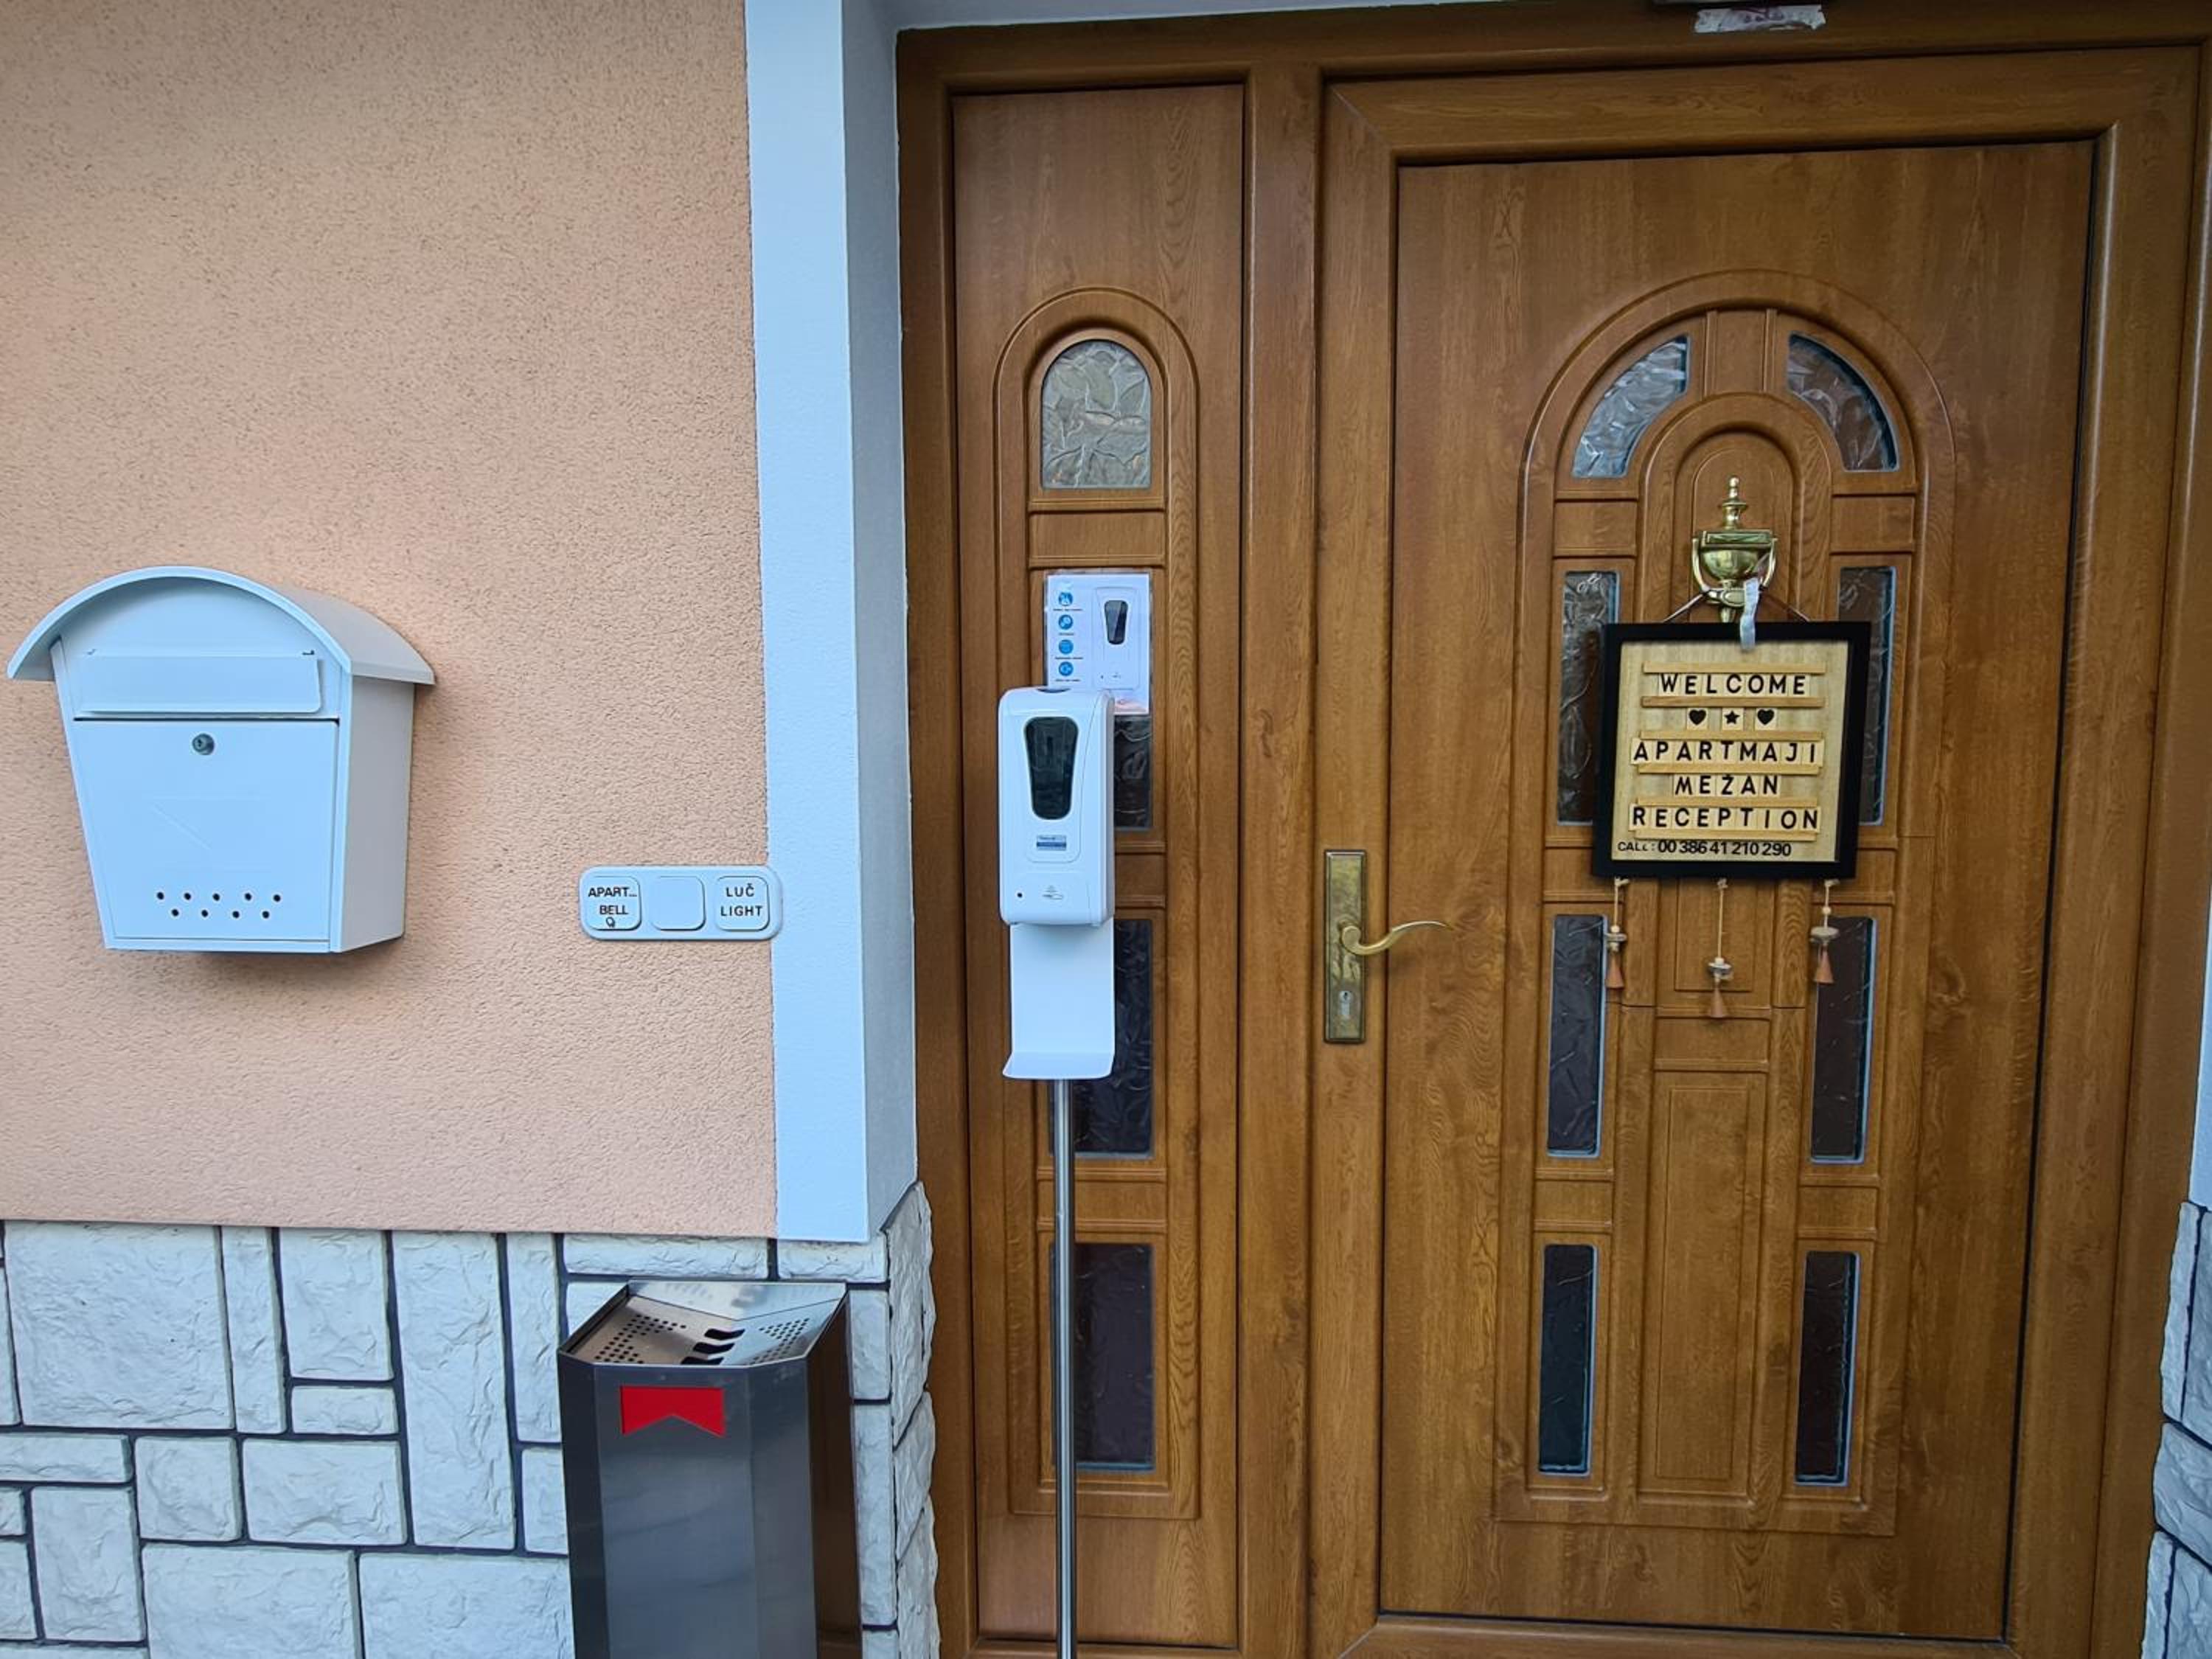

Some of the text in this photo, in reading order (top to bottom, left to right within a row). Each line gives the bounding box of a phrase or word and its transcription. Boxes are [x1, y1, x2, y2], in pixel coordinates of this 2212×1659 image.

[1660, 672, 1806, 695] WELCOME
[1632, 740, 1816, 763] APARTMAJI
[1632, 806, 1819, 830] RECEPTION
[726, 883, 755, 897] LUČ
[599, 905, 629, 915] BELL
[720, 905, 764, 917] LIGHT
